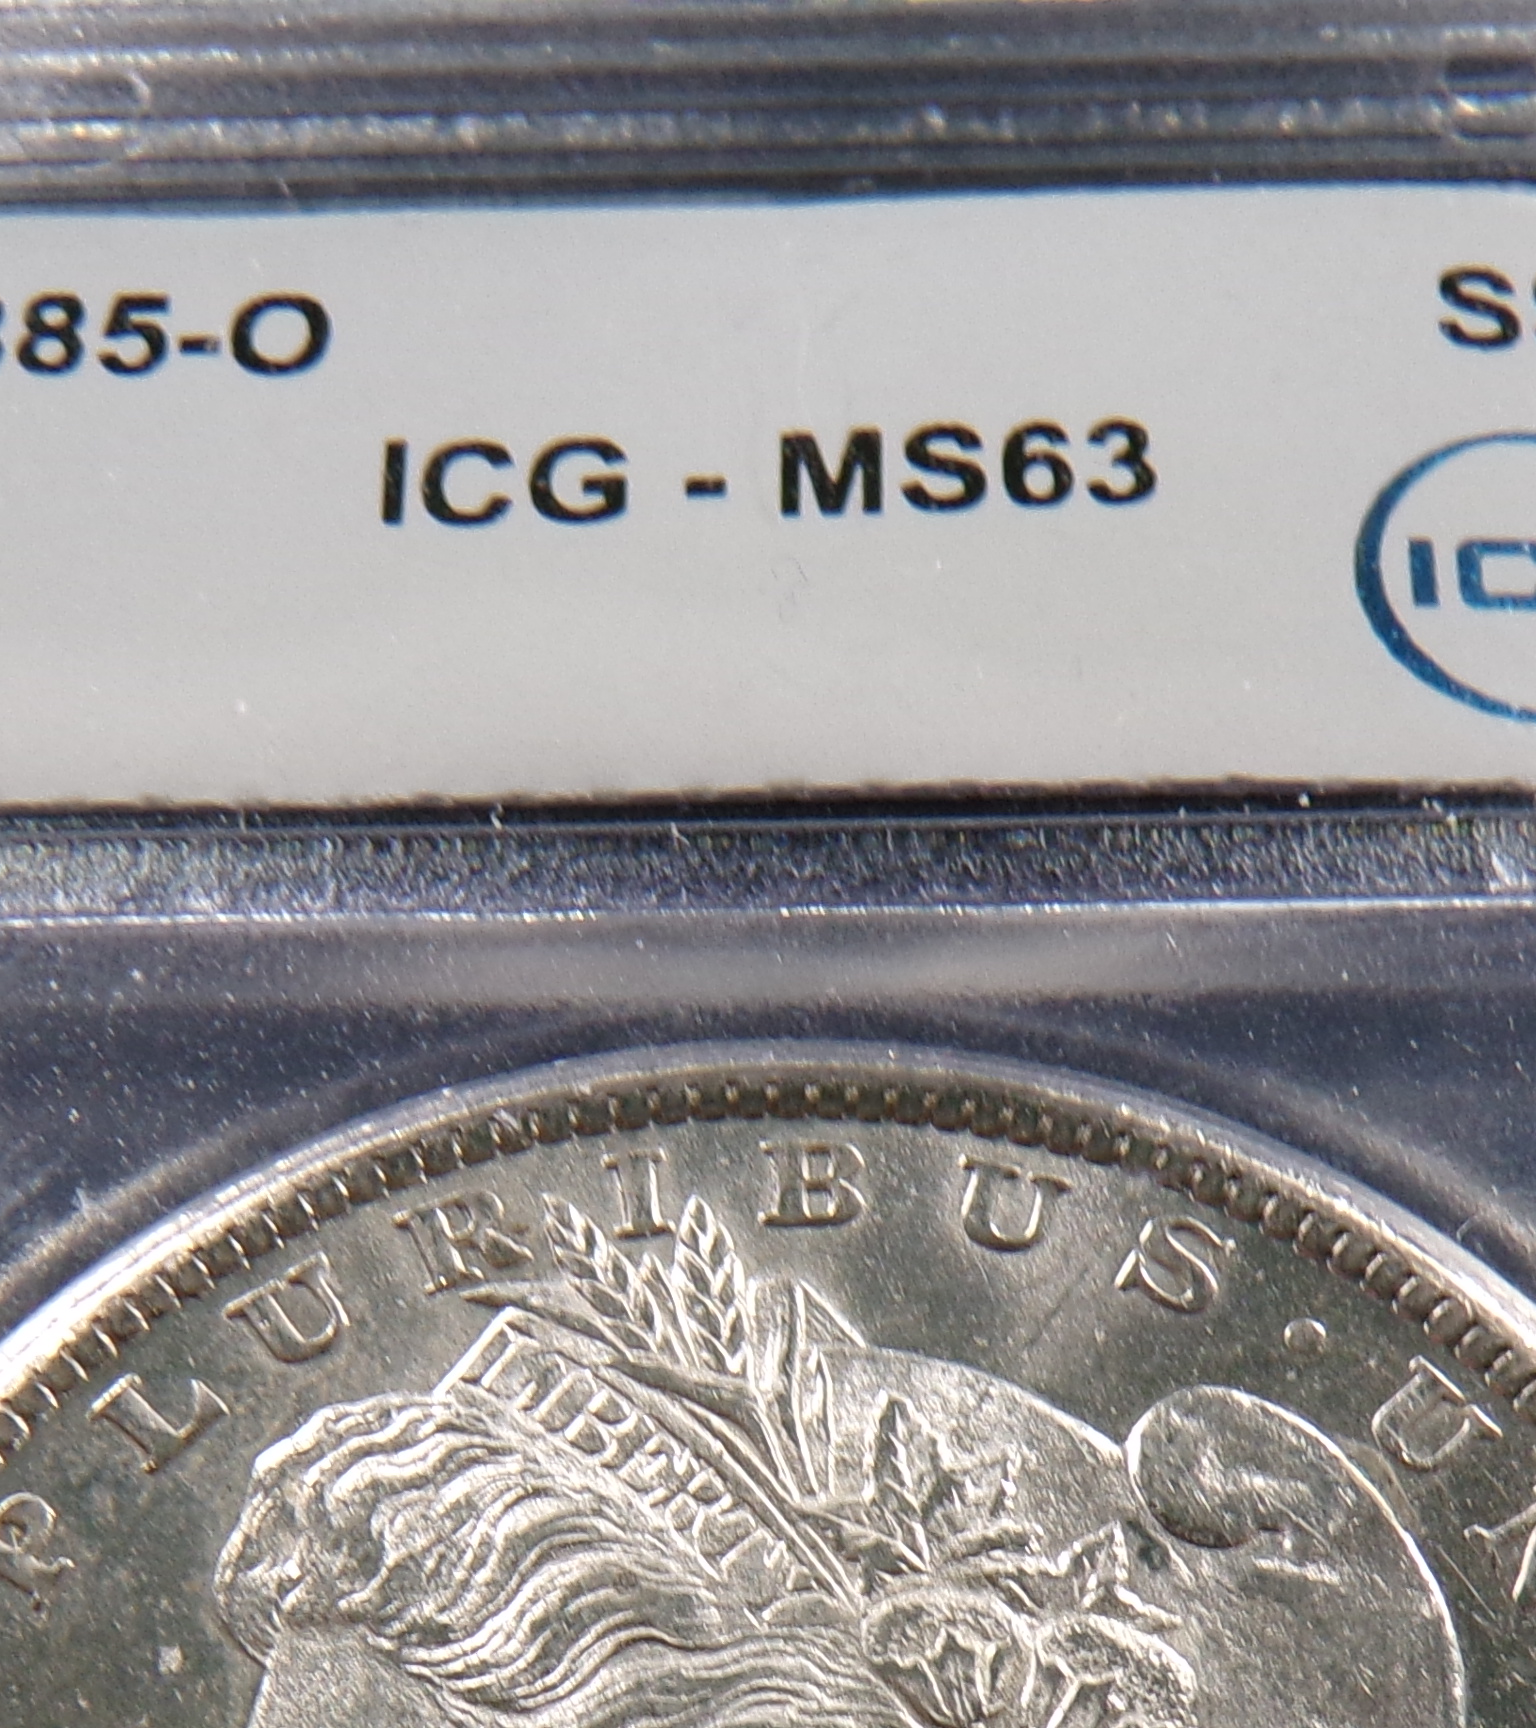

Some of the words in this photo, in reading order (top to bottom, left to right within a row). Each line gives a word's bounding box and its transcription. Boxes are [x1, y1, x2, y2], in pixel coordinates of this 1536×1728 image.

[379, 434, 630, 526] ICG
[683, 472, 727, 500] -
[777, 418, 1158, 517] MS63
